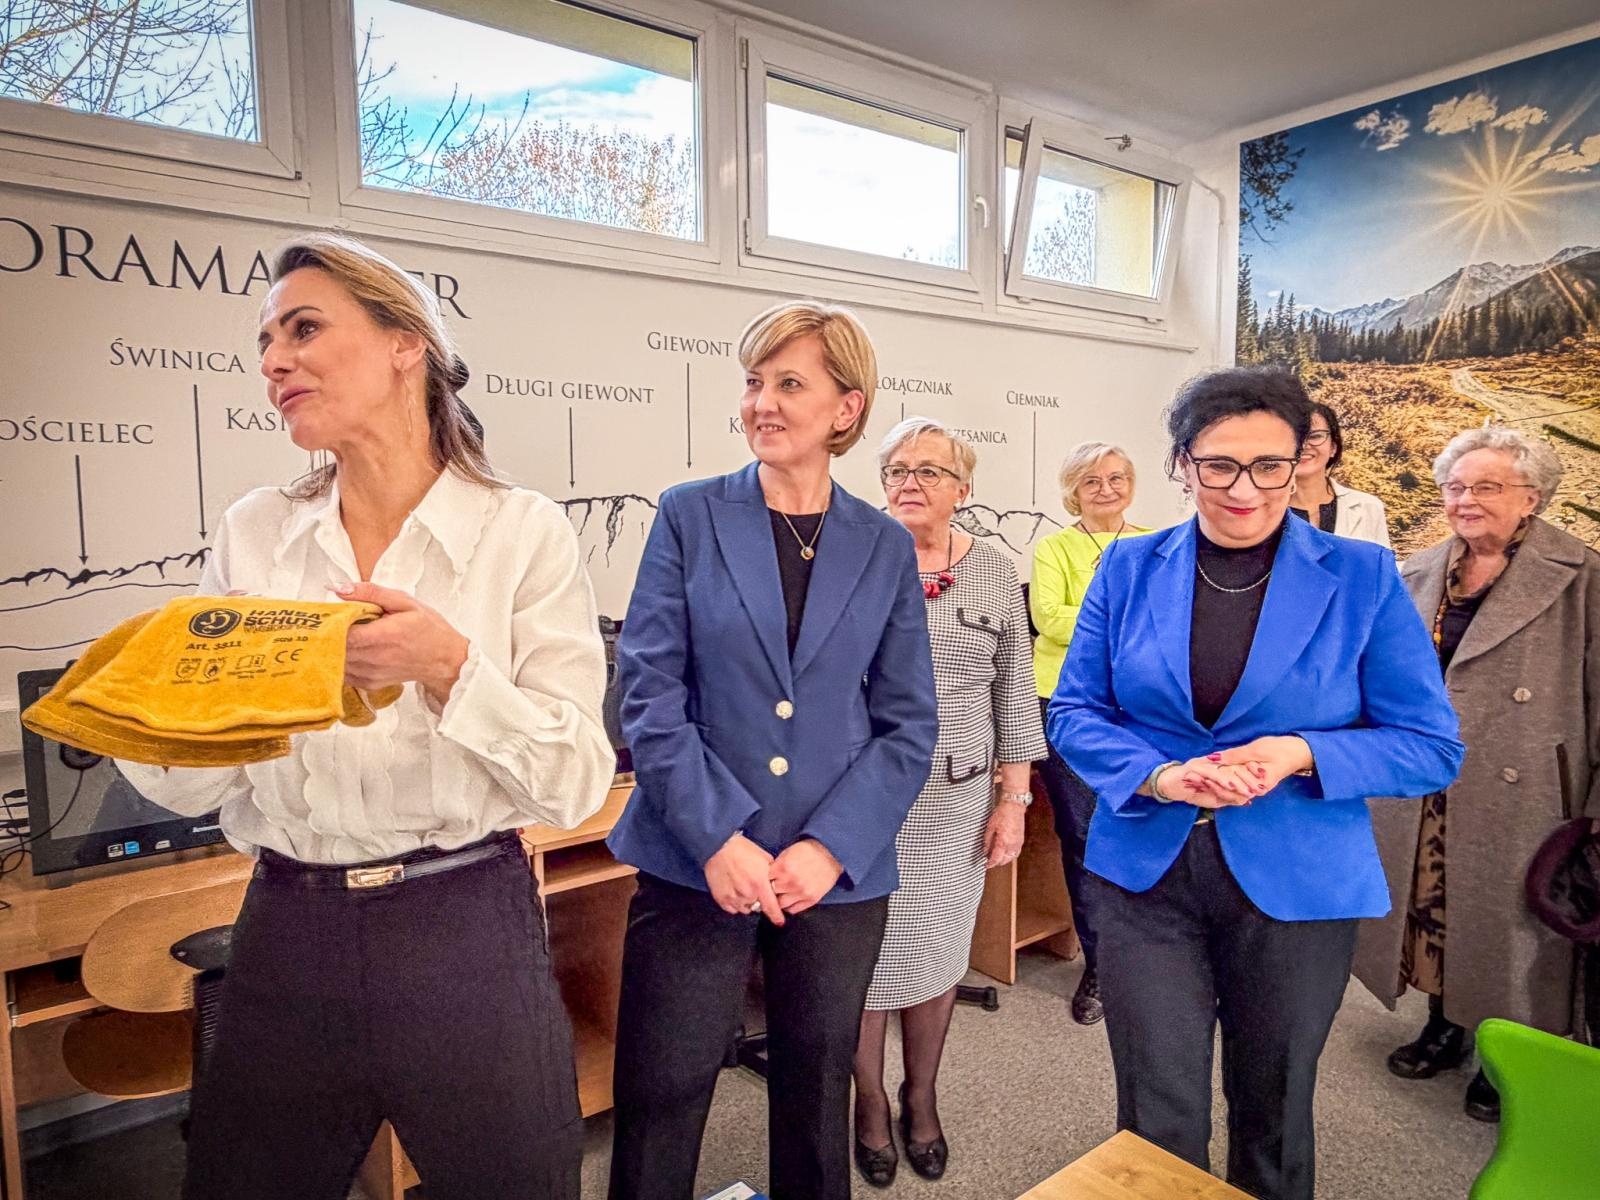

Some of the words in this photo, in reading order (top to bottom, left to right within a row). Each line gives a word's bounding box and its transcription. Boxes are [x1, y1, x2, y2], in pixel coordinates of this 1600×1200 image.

[109, 337, 246, 373] ŚWINICA
[646, 331, 733, 357] GIEWONT
[486, 374, 553, 397] DŁUGI
[561, 382, 655, 404] GIEWONT
[1005, 390, 1060, 409] CIEMNIAK
[244, 616, 323, 628] SCHUTZ
[249, 609, 321, 620] HANSA
